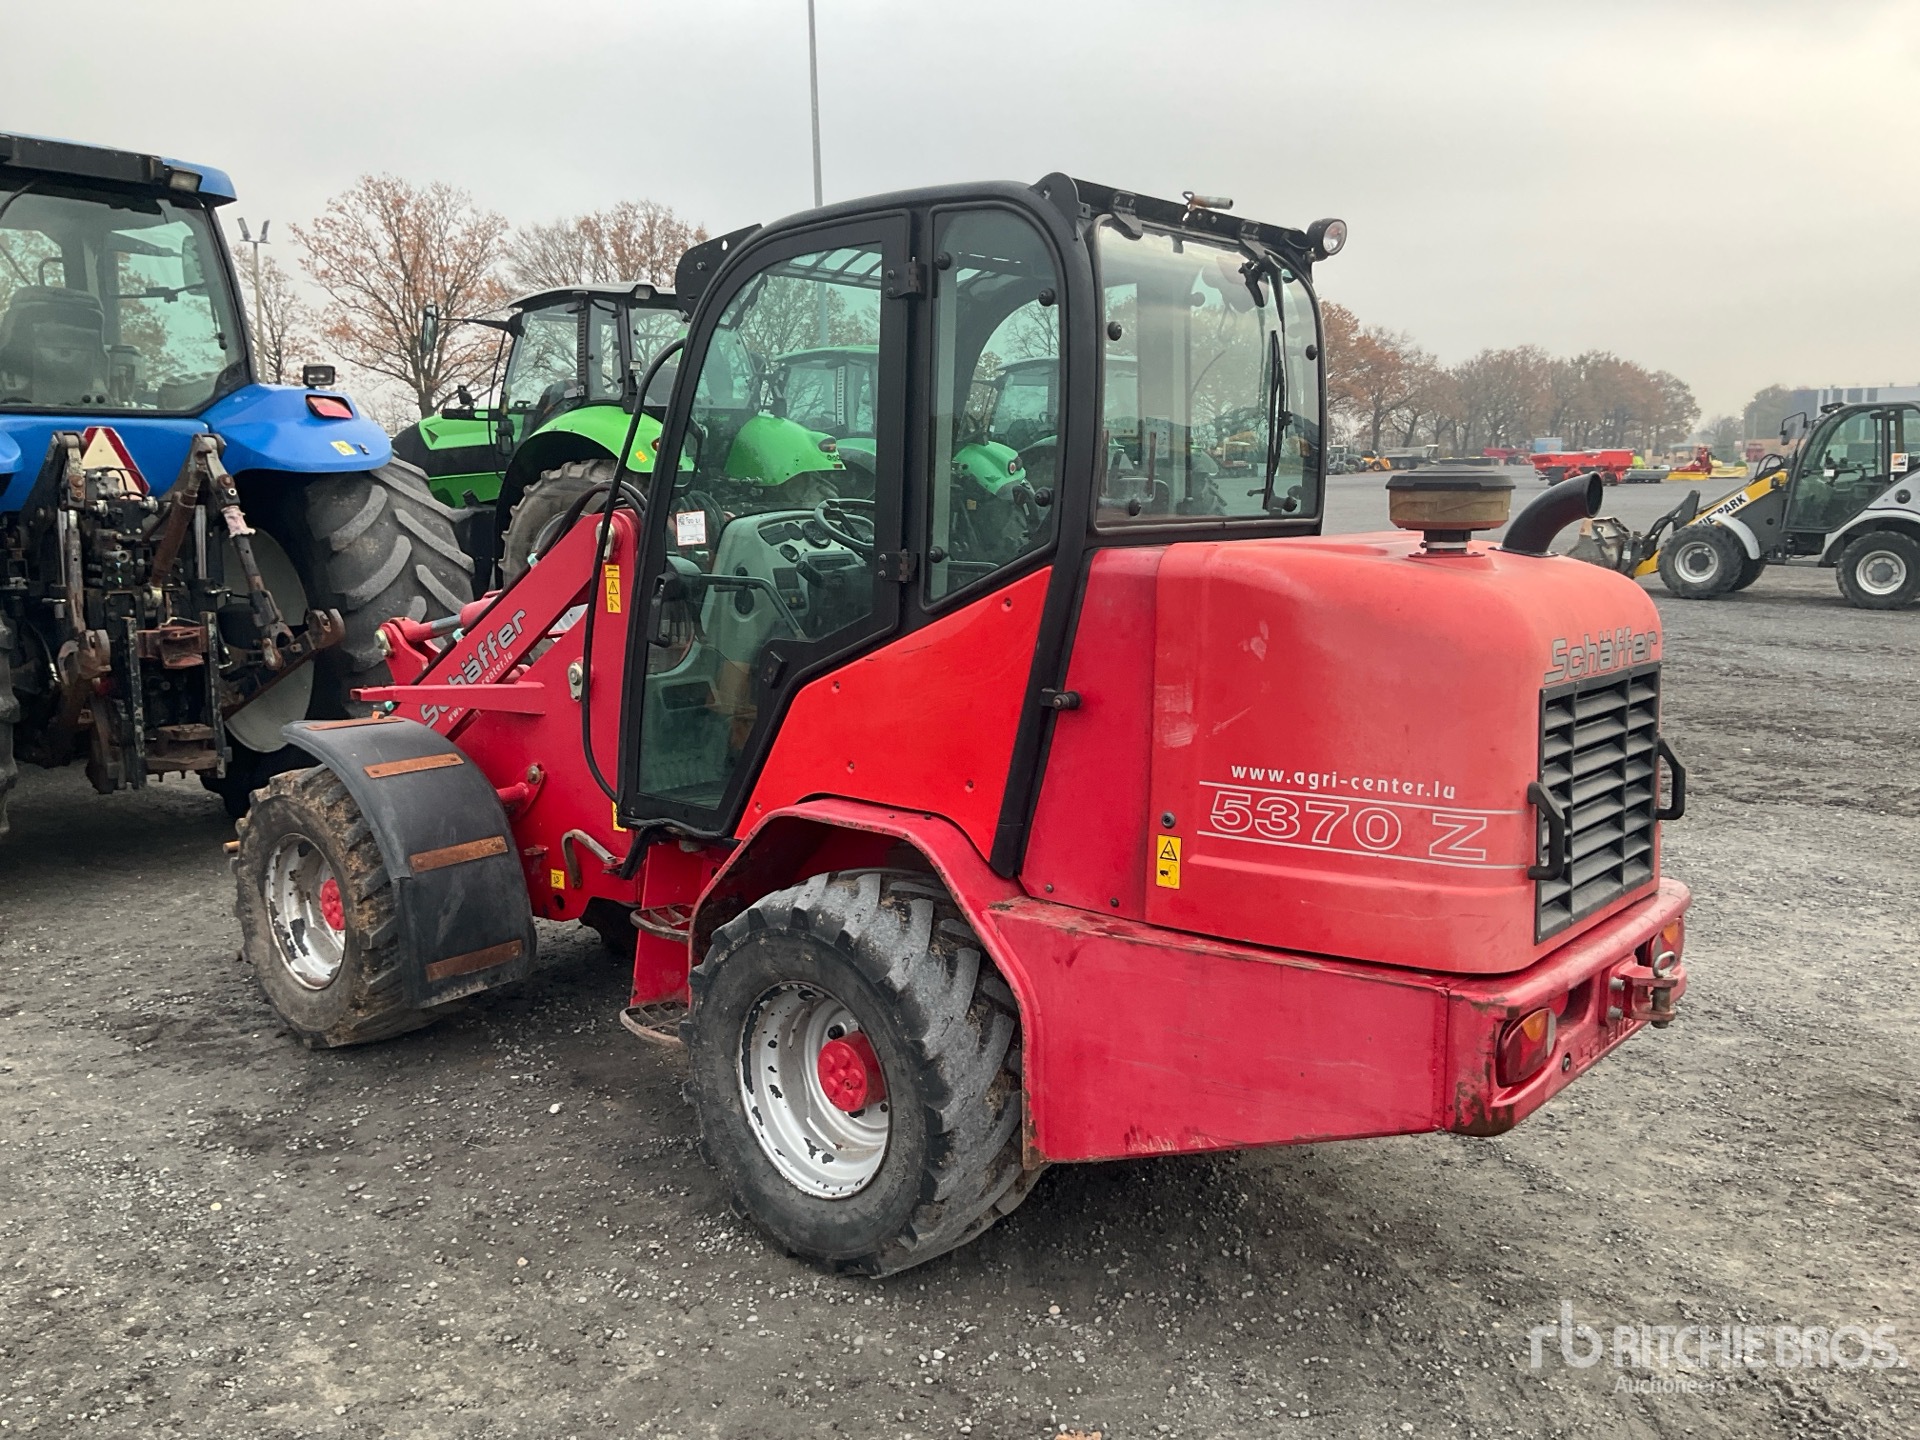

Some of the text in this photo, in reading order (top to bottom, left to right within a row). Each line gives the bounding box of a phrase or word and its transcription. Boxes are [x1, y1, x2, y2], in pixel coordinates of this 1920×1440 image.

[1543, 626, 1659, 685] Schäffer
[1231, 765, 1456, 799] www.agri-center.lu
[1209, 790, 1487, 861] 5370 Z
